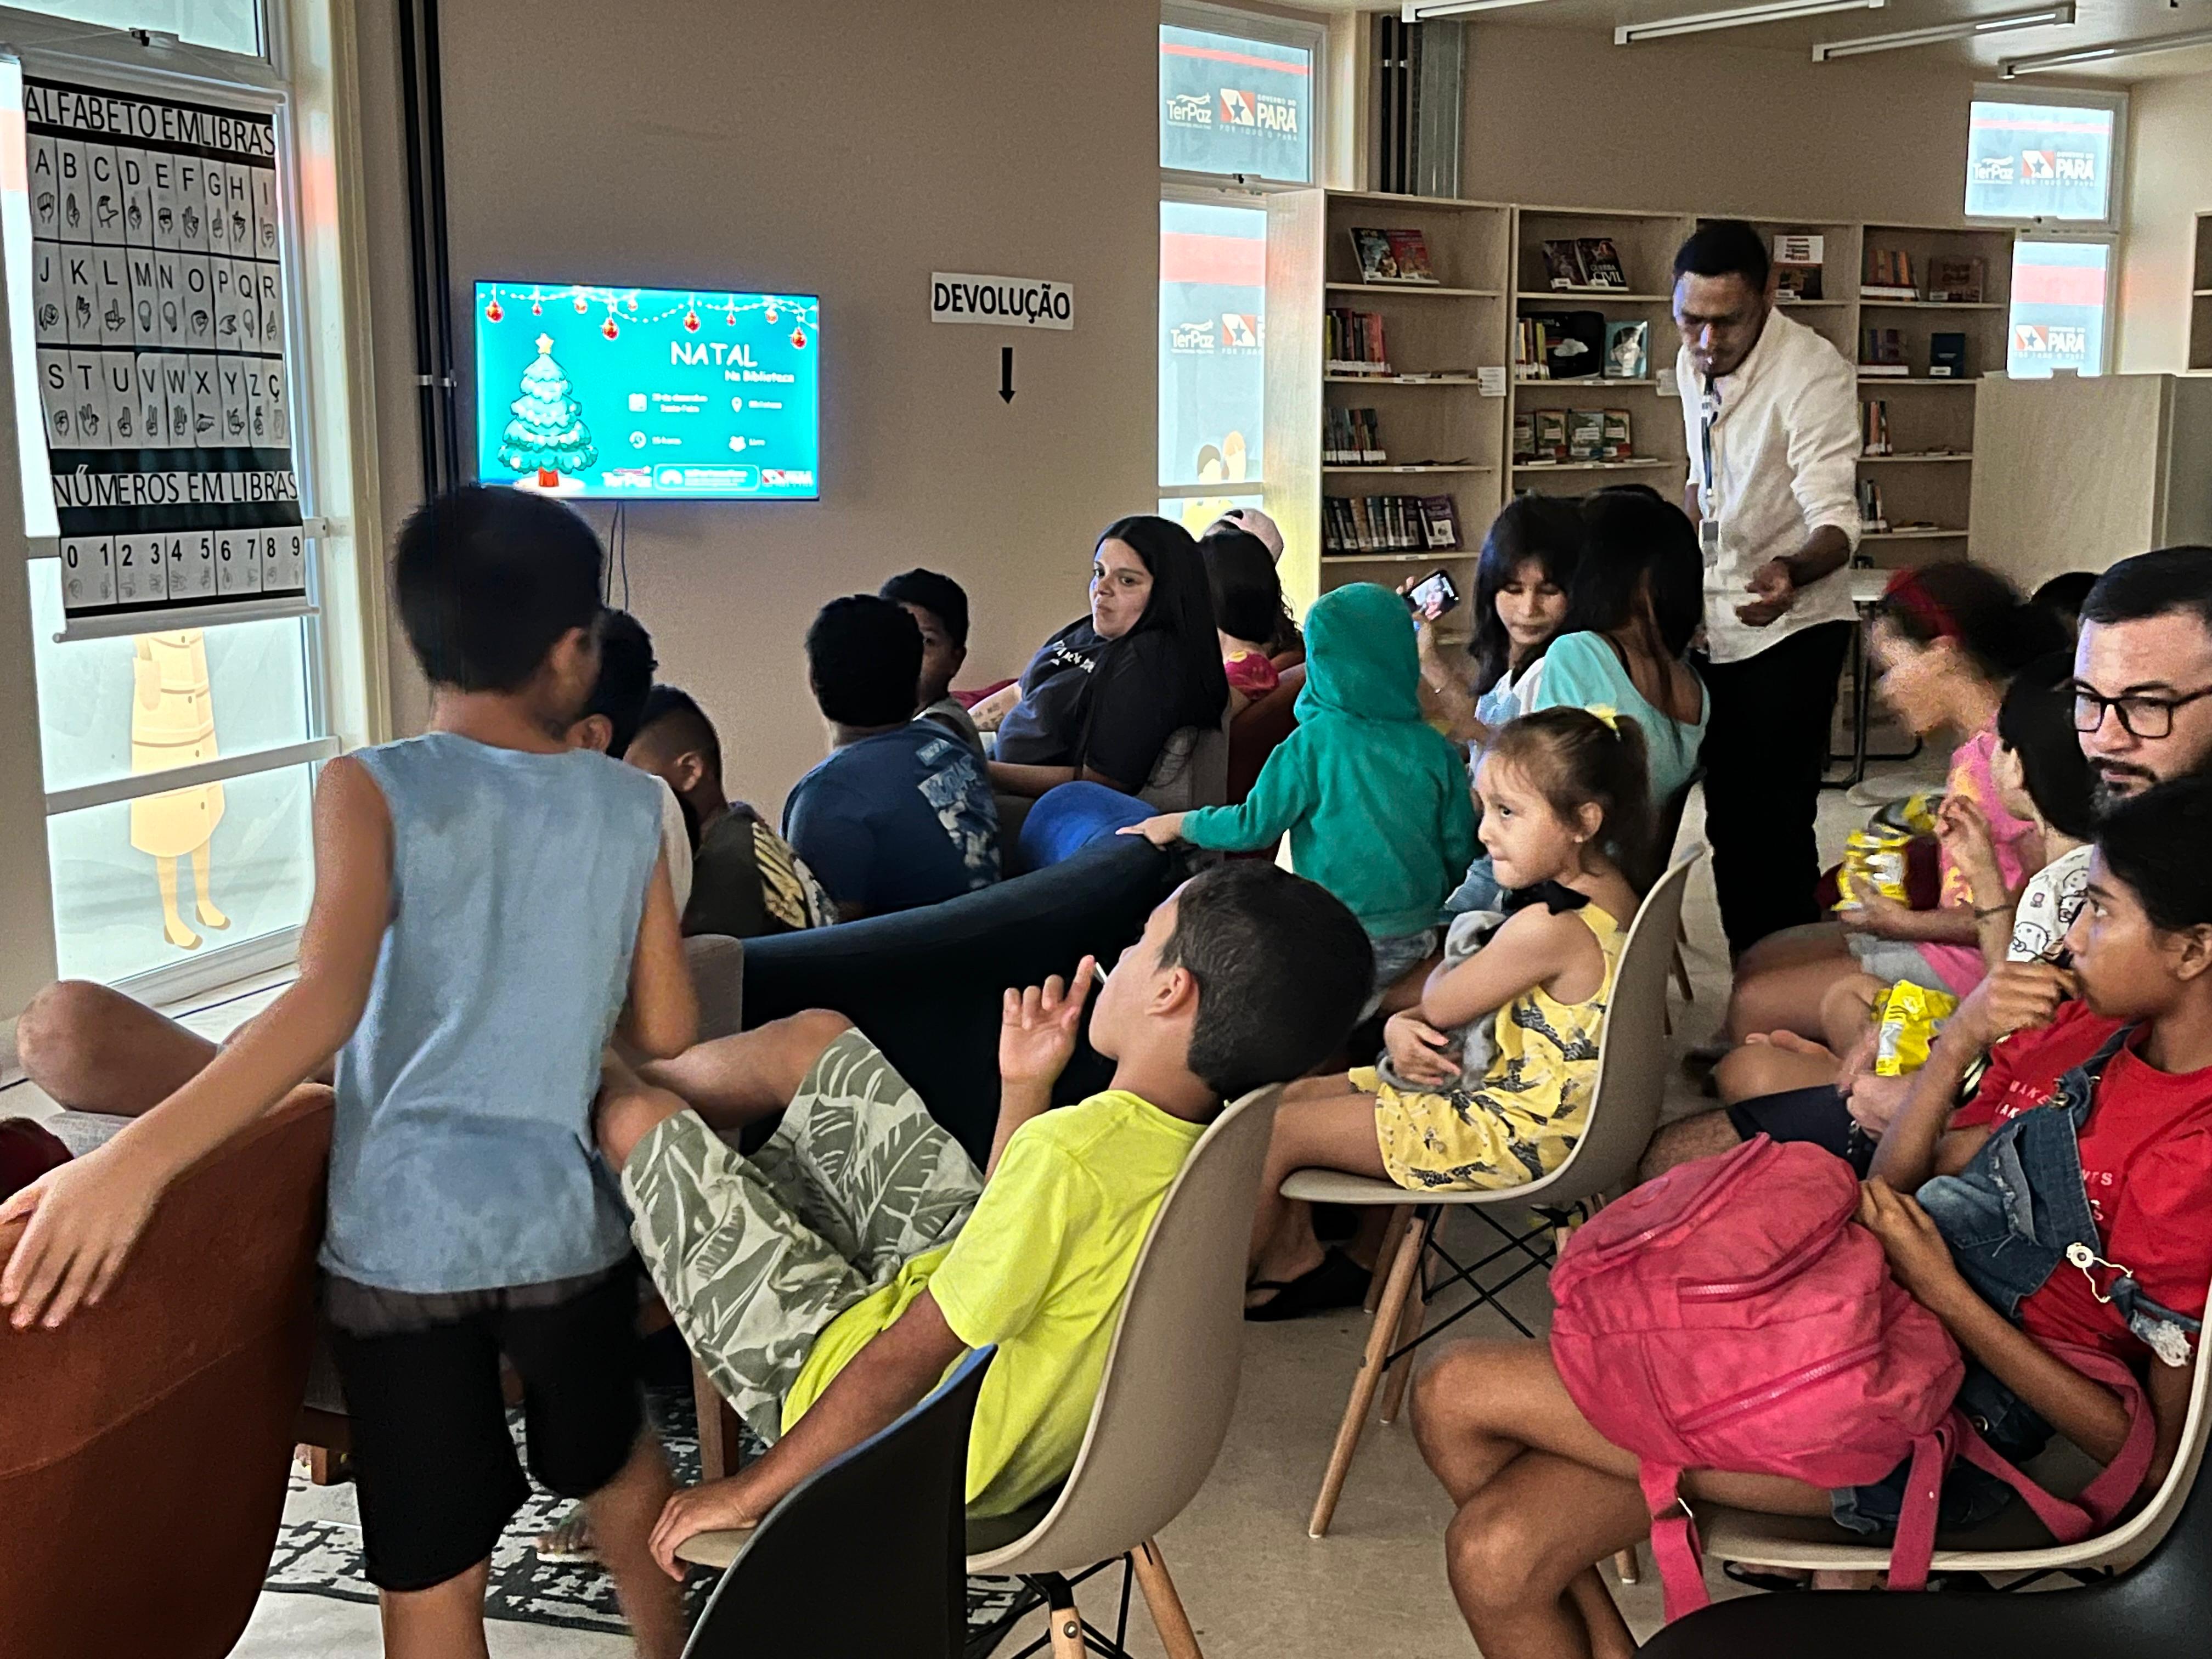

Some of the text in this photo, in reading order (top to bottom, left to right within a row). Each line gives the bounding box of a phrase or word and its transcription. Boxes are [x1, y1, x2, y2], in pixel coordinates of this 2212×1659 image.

[25, 87, 275, 155] ALFABETO EM LIBRAS
[1166, 99, 1212, 123] TerPaz
[35, 149, 268, 205] A B C D E F G H I
[40, 257, 276, 298] J K L M N O P Q R
[1593, 272, 1624, 283] CIVIL
[934, 283, 1070, 324] DEVOLUÇÃO
[671, 341, 758, 367] NATAL
[1170, 329, 1214, 348] TerPaz
[49, 364, 280, 402] S T U V W X Y Z Ç
[52, 464, 298, 506] NÚMEROS EM LIBRAS
[67, 536, 300, 568] 0 1 2 3 4 5 6 7 8 9
